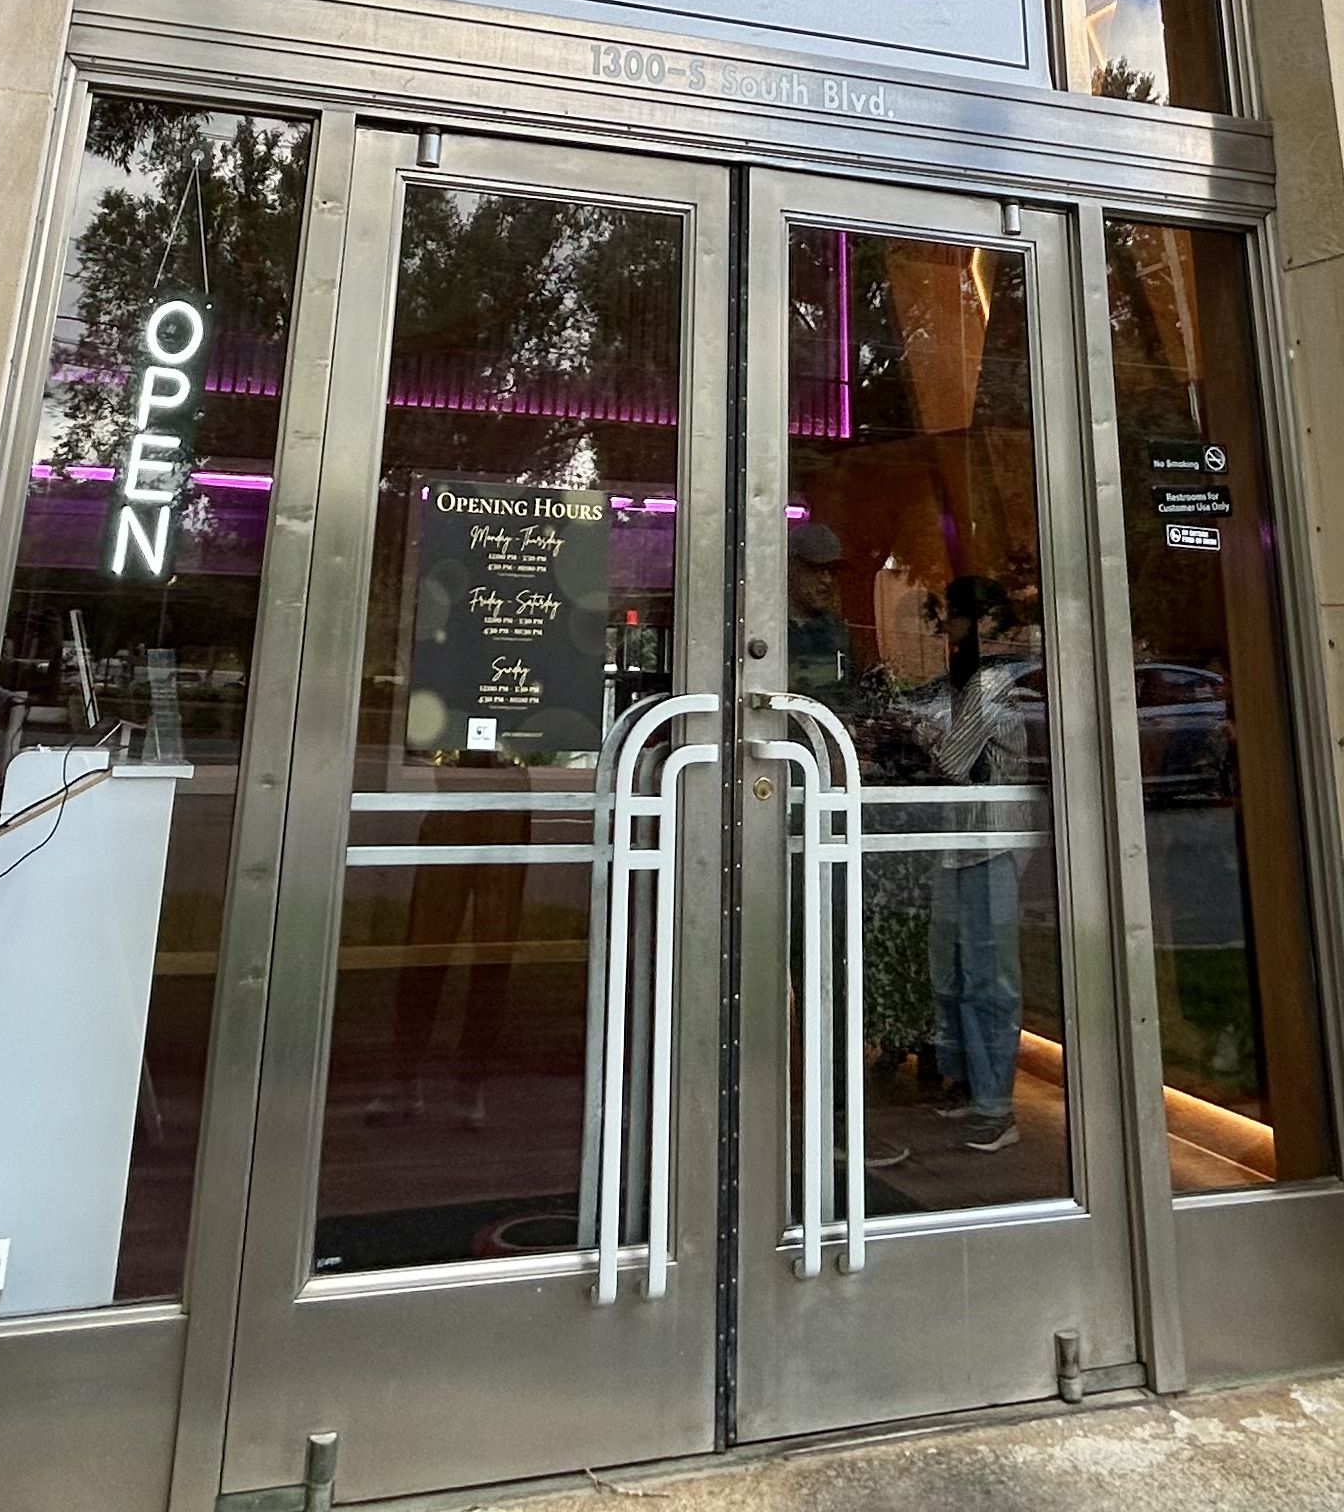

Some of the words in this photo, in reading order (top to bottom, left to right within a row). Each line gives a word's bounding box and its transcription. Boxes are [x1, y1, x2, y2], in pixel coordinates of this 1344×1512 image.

[721, 70, 810, 106] South
[822, 80, 897, 119] Blvd.
[111, 300, 204, 576] OPEN
[1212, 501, 1230, 513] Only
